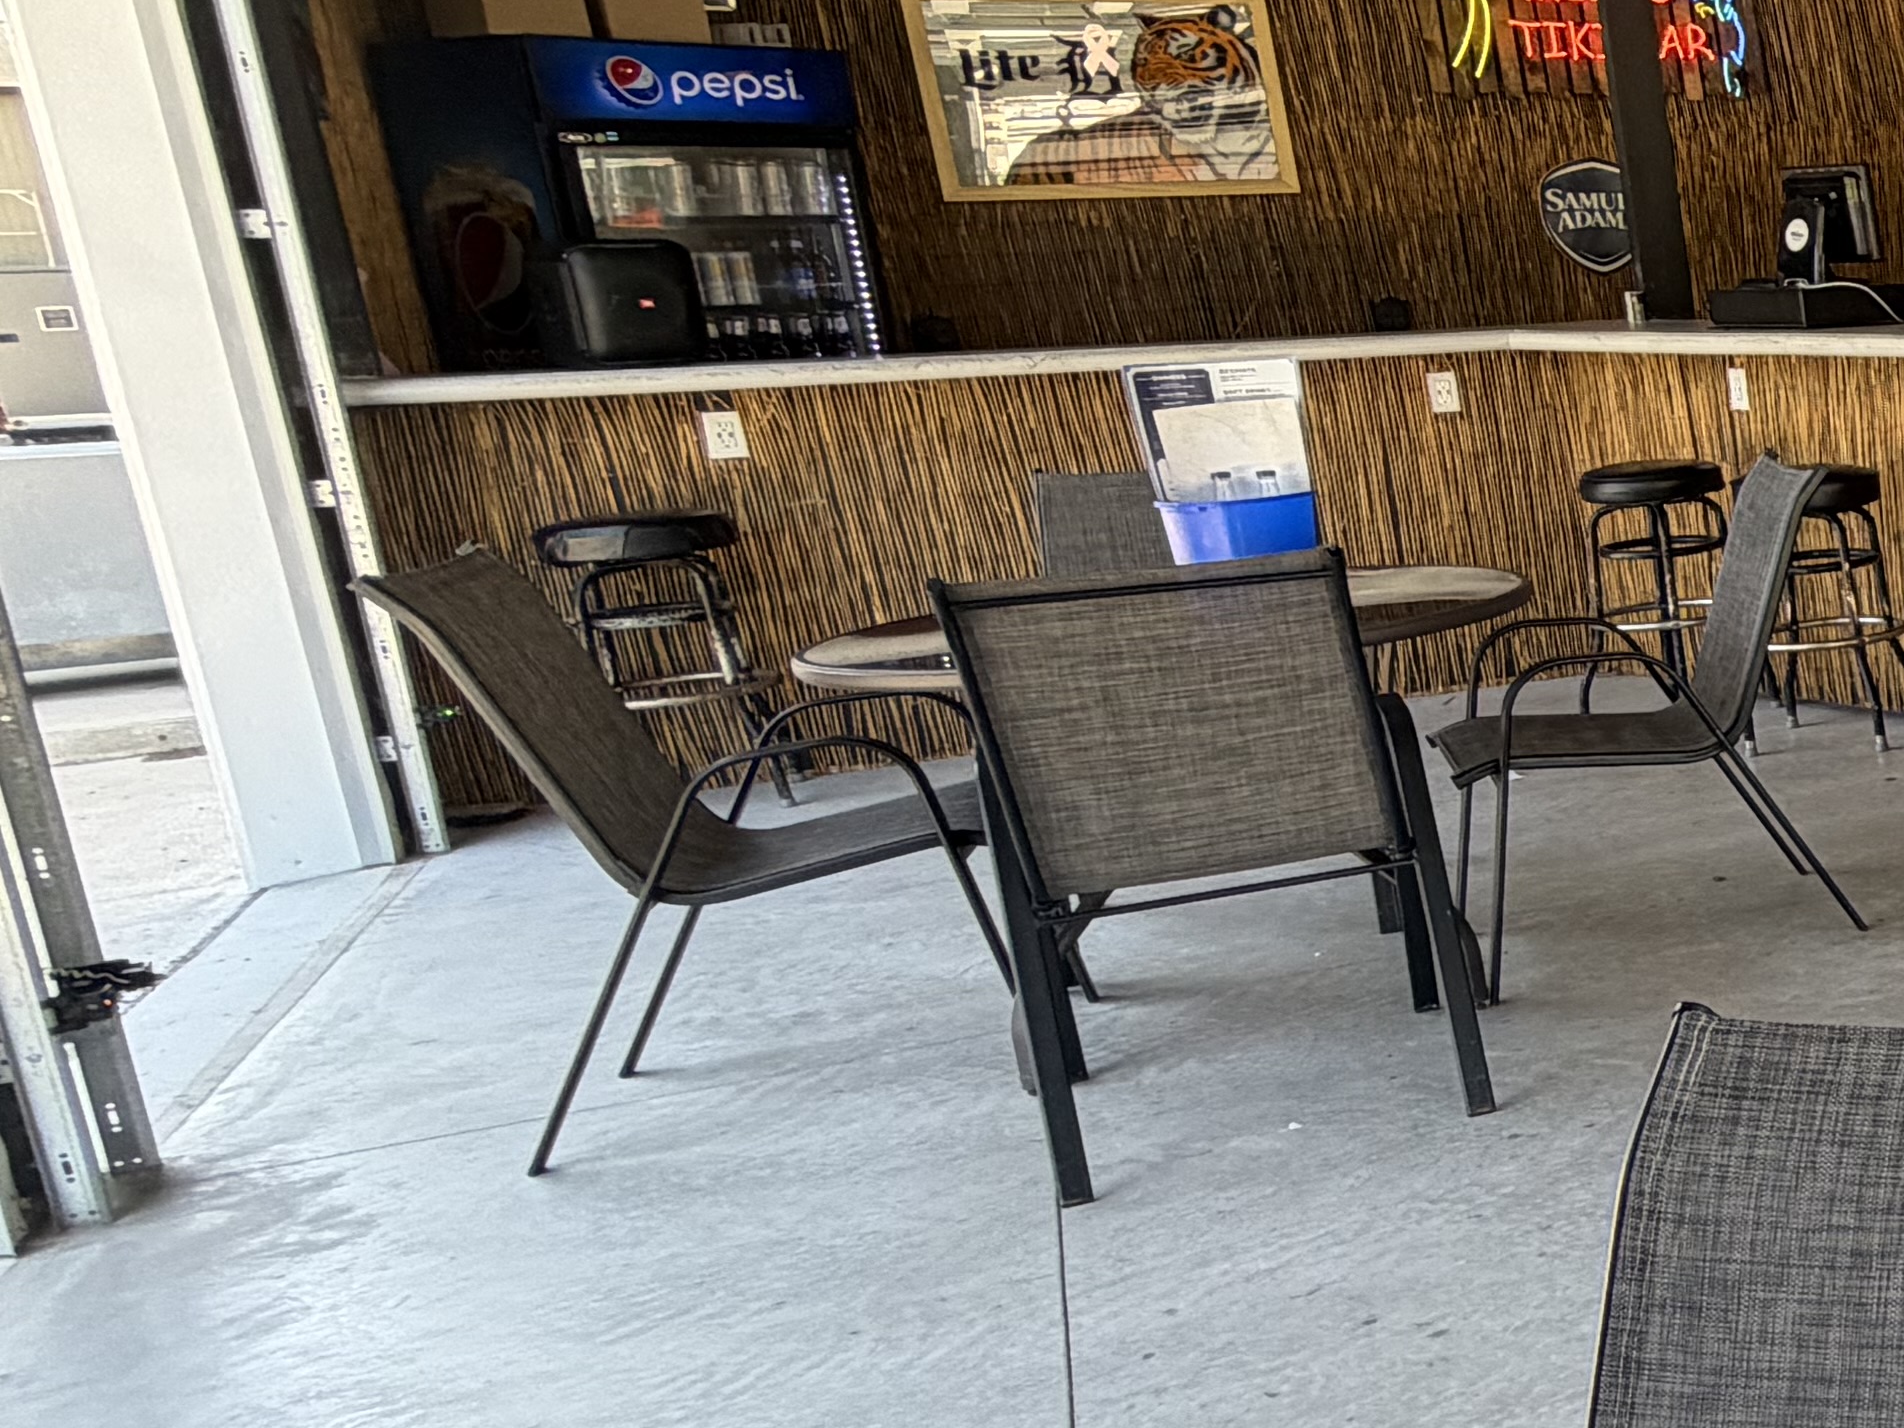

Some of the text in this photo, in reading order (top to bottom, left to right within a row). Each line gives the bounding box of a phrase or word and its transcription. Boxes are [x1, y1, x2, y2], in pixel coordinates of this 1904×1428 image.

[1658, 23, 1716, 62] AR
[670, 67, 806, 107] pepsi
[957, 48, 1041, 90] Lite
[1558, 210, 1629, 233] ADAM
